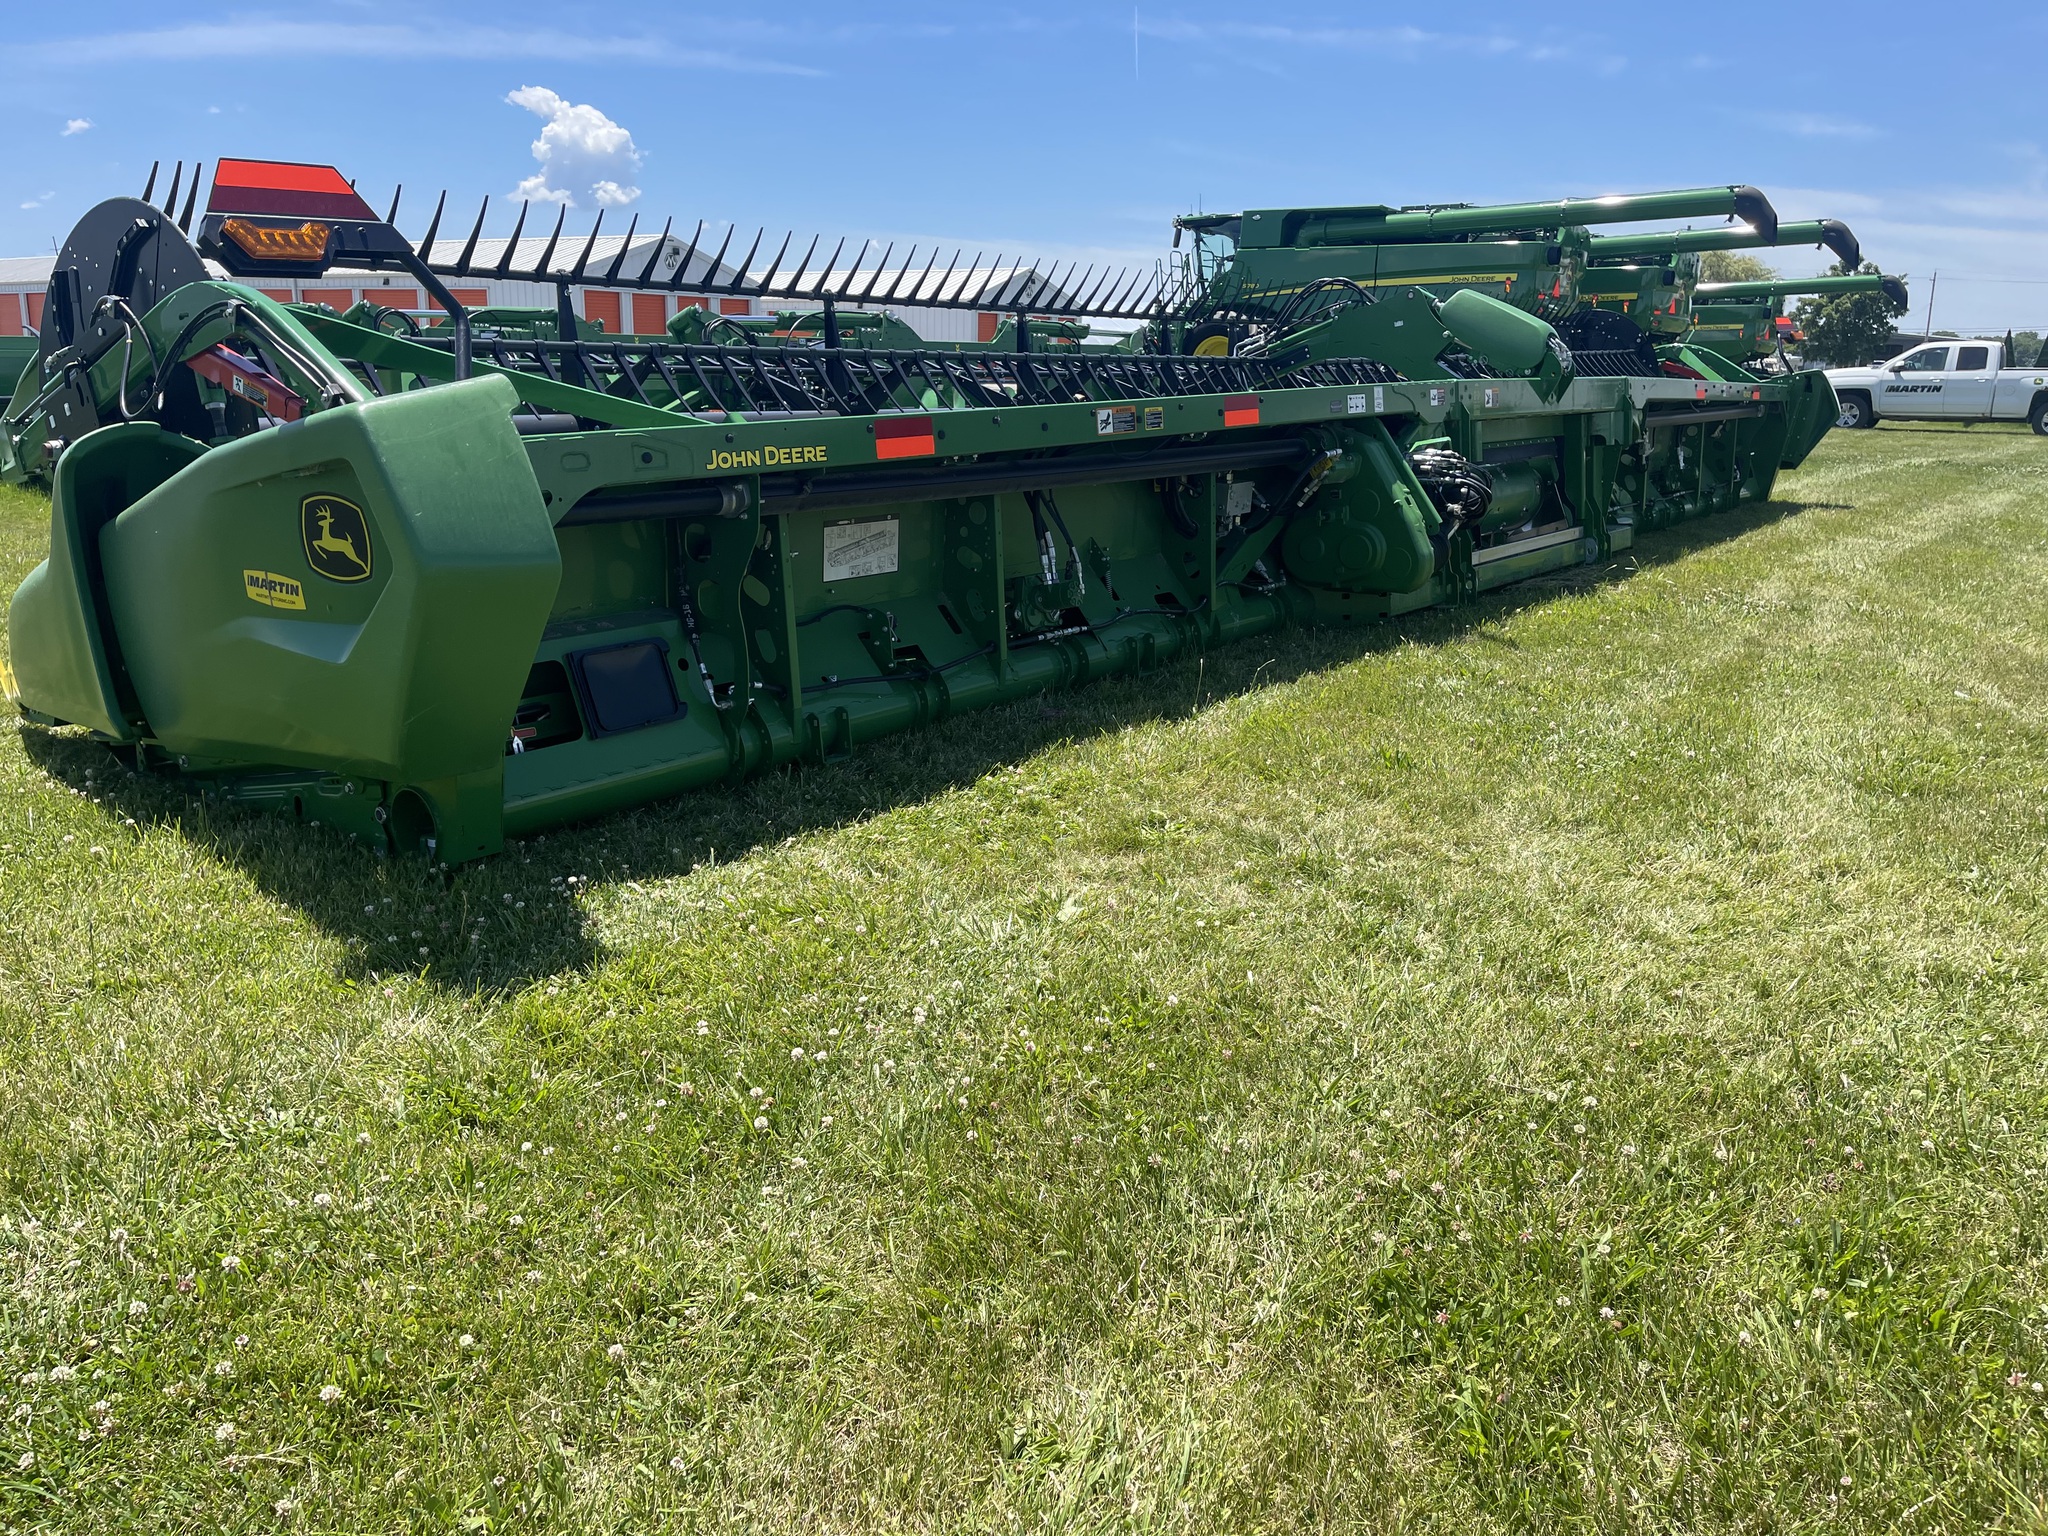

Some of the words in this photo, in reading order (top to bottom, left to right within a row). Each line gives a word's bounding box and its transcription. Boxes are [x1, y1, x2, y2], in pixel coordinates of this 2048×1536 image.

[1885, 385, 1943, 393] MARTIN
[706, 449, 760, 470] JOHN
[763, 445, 827, 465] DEERE
[248, 575, 300, 597] MARTIN
